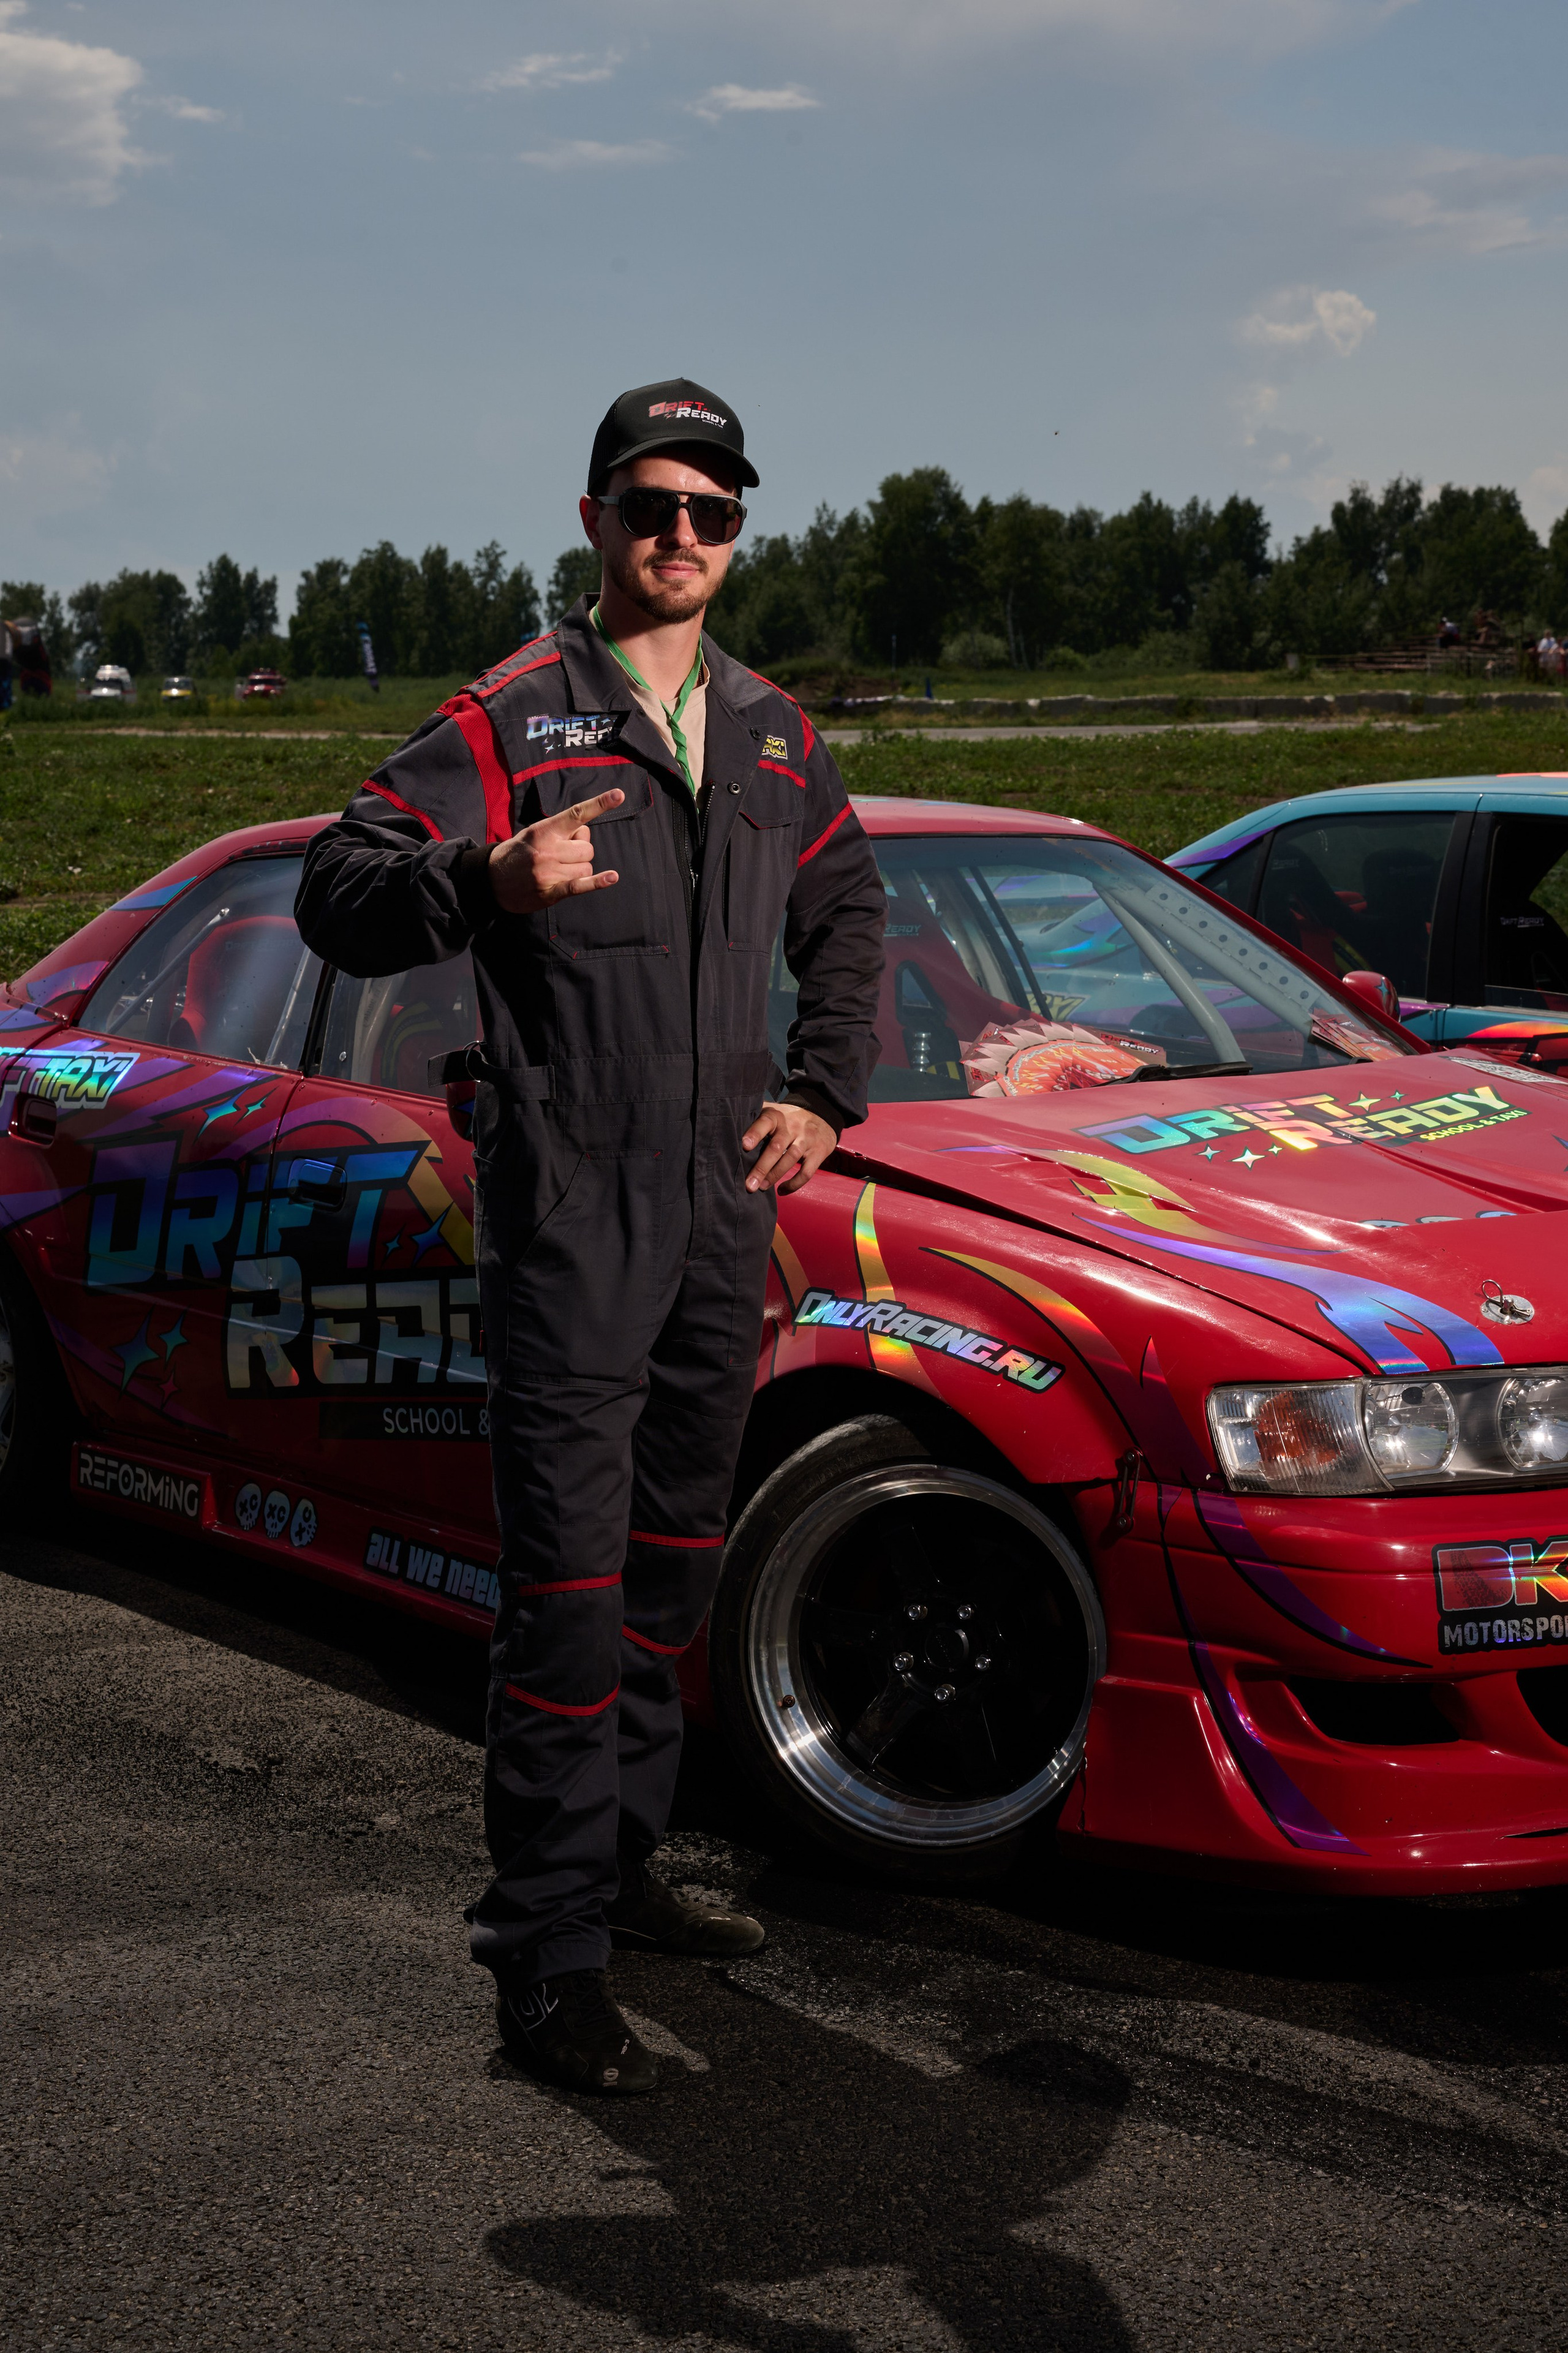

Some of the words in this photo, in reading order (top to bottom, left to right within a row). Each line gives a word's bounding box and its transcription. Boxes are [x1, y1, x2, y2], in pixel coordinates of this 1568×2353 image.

[648, 401, 704, 418] DRIFT
[676, 407, 727, 426] READY
[526, 714, 601, 740] DRIFT
[1074, 1093, 1353, 1153] DRIFT
[1253, 1086, 1510, 1151] READY
[1419, 1120, 1483, 1141] SCHOOL
[1491, 1109, 1528, 1122] TAXI
[88, 1139, 420, 1286] DRIFT
[382, 1407, 470, 1435] SCHOOL
[1437, 1540, 1568, 1612] DK
[1443, 1614, 1568, 1649] MOTORSPO
